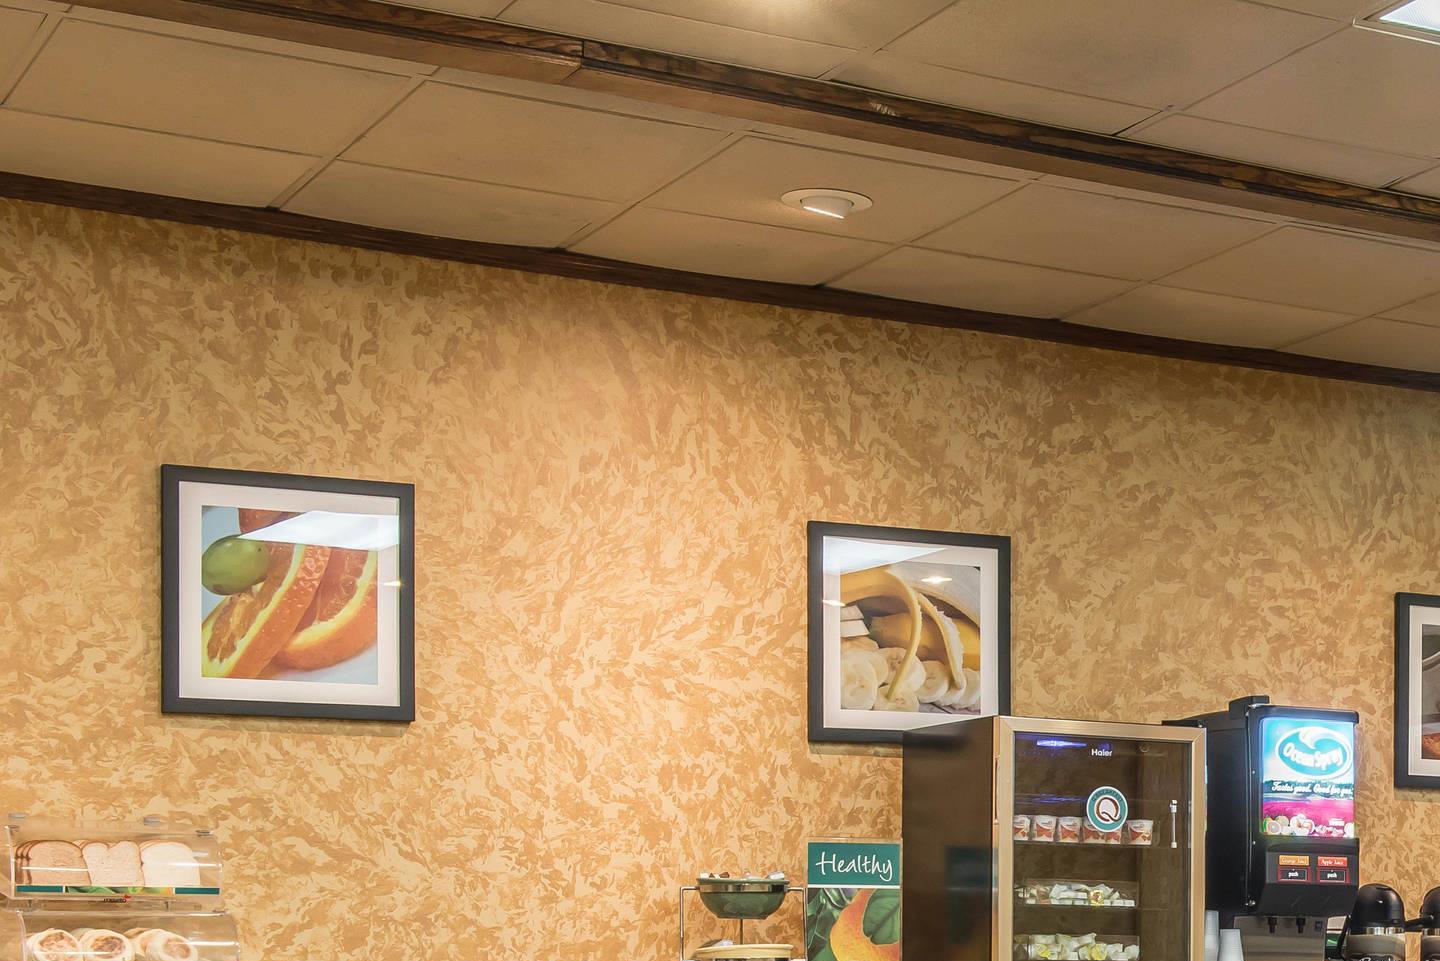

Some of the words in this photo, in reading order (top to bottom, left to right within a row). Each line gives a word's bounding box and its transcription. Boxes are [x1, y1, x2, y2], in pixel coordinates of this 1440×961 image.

[1091, 748, 1113, 757] Haier
[1283, 742, 1314, 768] Ocean
[1314, 746, 1344, 771] Spray
[815, 851, 893, 882] Healthy
